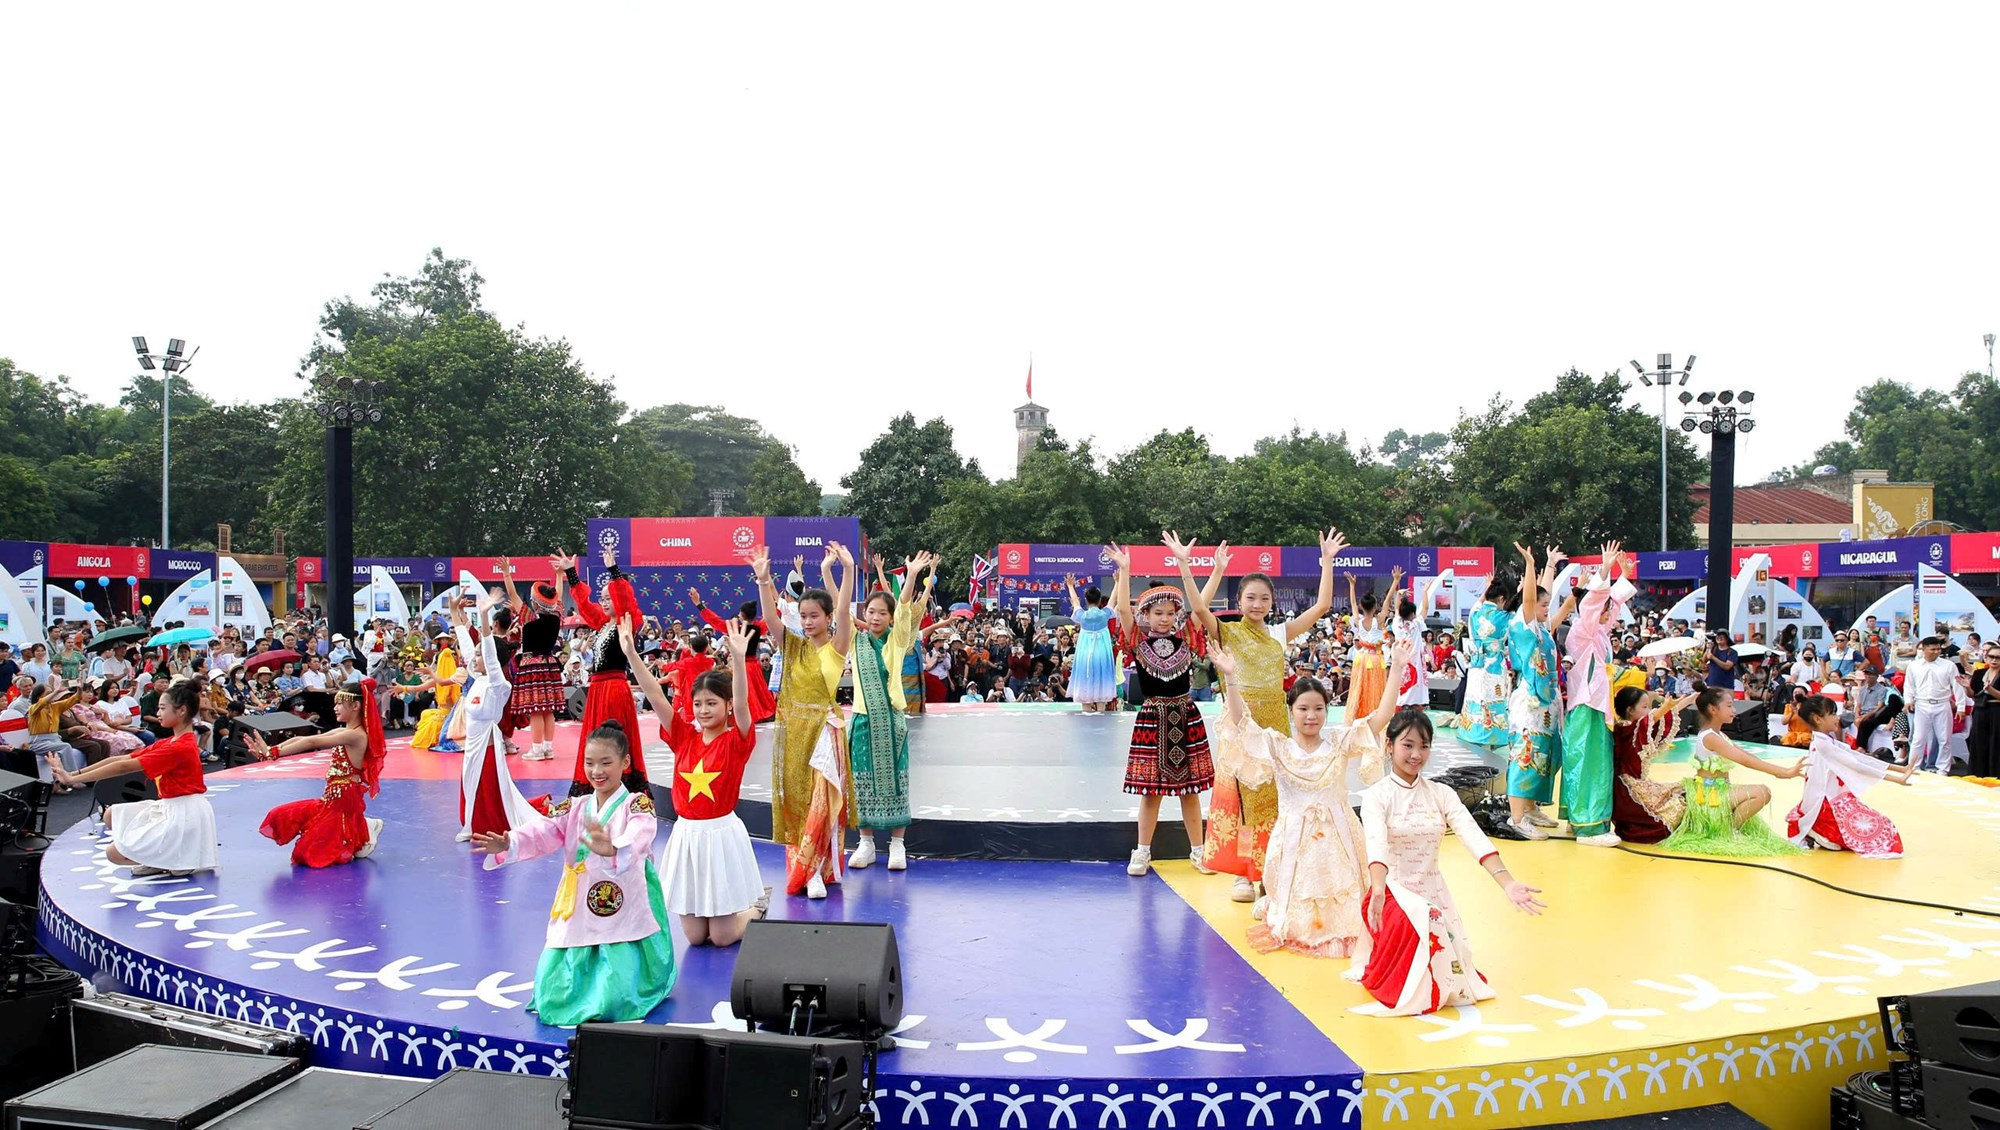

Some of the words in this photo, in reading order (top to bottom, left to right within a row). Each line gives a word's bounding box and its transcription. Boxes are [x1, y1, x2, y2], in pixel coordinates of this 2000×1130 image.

[659, 538, 692, 547] CHINA
[795, 537, 823, 546] INDIA
[76, 556, 111, 568] ANGOLA
[1840, 551, 1897, 565] NICARAGUA
[168, 560, 201, 571] MOROCCO
[352, 566, 370, 574] UDI
[383, 566, 411, 574] ABIA
[492, 565, 516, 573] IRN
[1658, 560, 1676, 571] PERU
